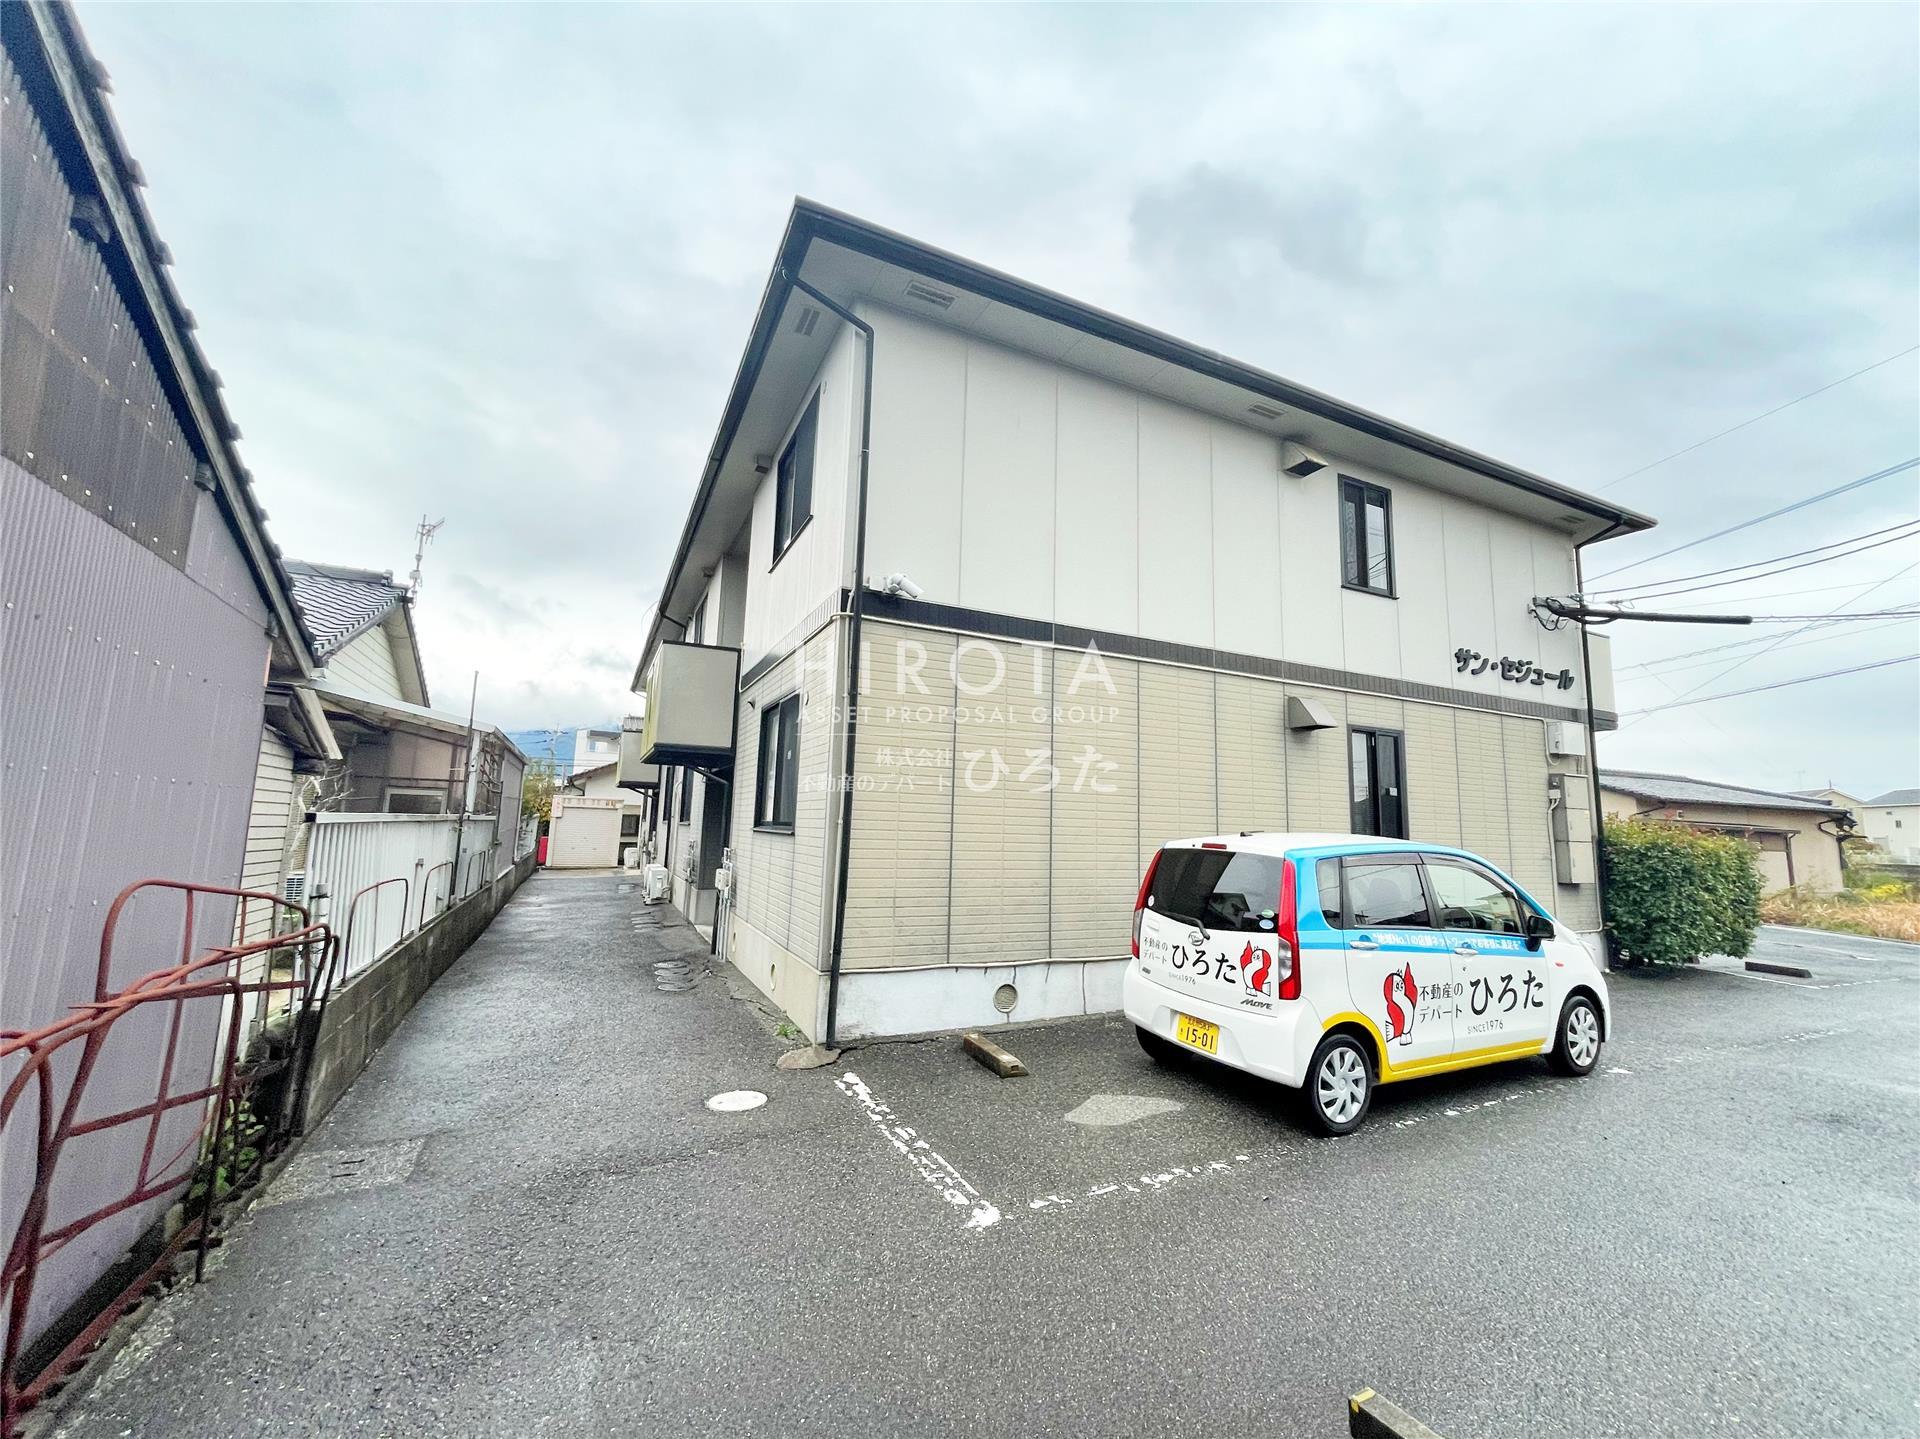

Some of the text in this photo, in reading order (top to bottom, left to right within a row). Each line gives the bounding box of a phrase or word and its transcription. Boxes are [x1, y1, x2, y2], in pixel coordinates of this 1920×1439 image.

[1454, 647, 1575, 690] サン・セジュール
[1171, 944, 1237, 984] ひろた
[1240, 998, 1273, 1010] MOVE
[1419, 982, 1464, 1001] 不動産の
[1470, 969, 1544, 1016] ひろた
[1419, 1003, 1463, 1024] デパート
